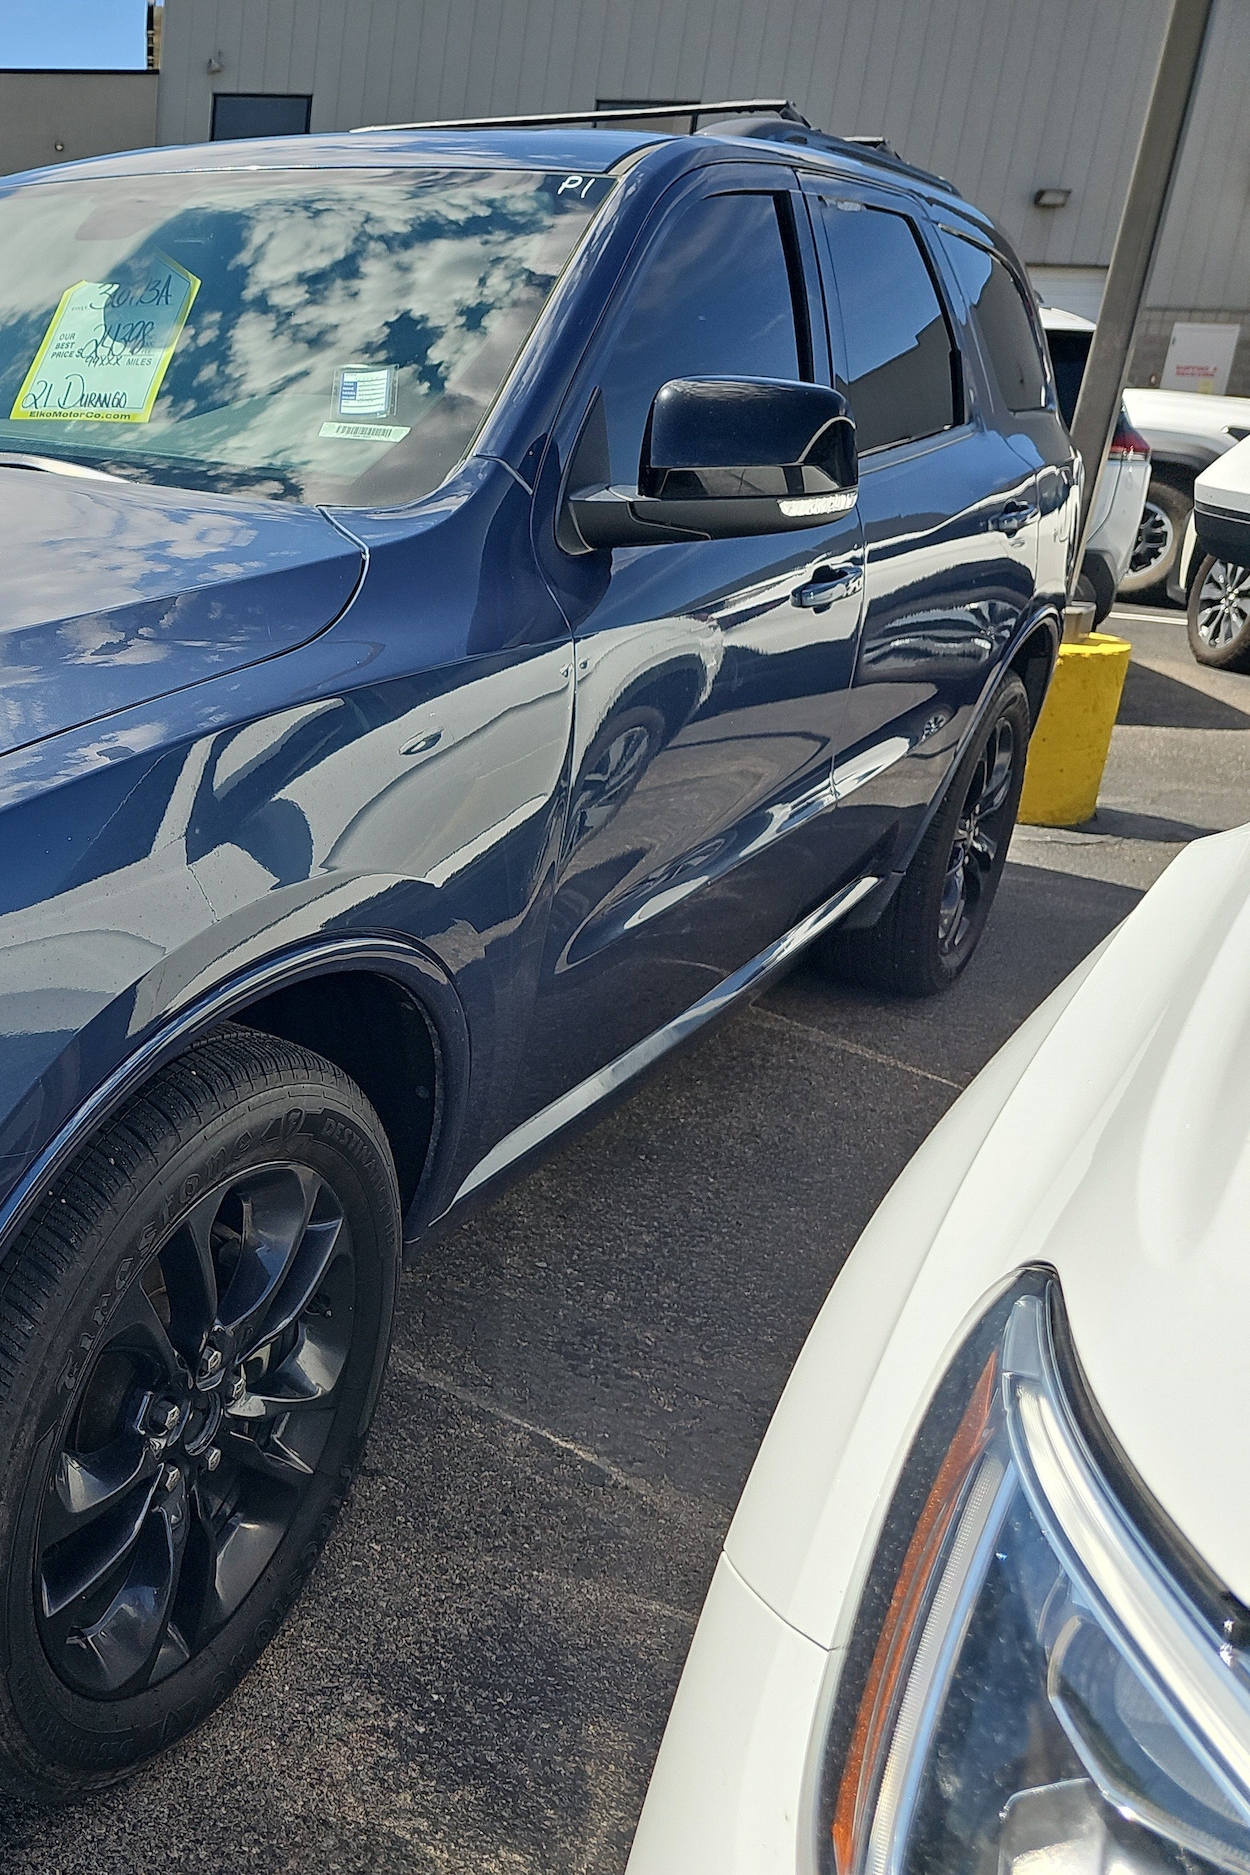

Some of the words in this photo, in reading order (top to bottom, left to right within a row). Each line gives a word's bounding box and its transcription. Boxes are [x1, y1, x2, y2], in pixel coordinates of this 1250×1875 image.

[59, 332, 76, 341] OUR
[55, 342, 75, 350] BEST
[51, 350, 74, 359] PRICE
[126, 358, 153, 366] MILES
[21, 380, 53, 409] 21
[58, 373, 127, 409] DURANGO
[29, 411, 131, 420] ElkoMotorCo.com
